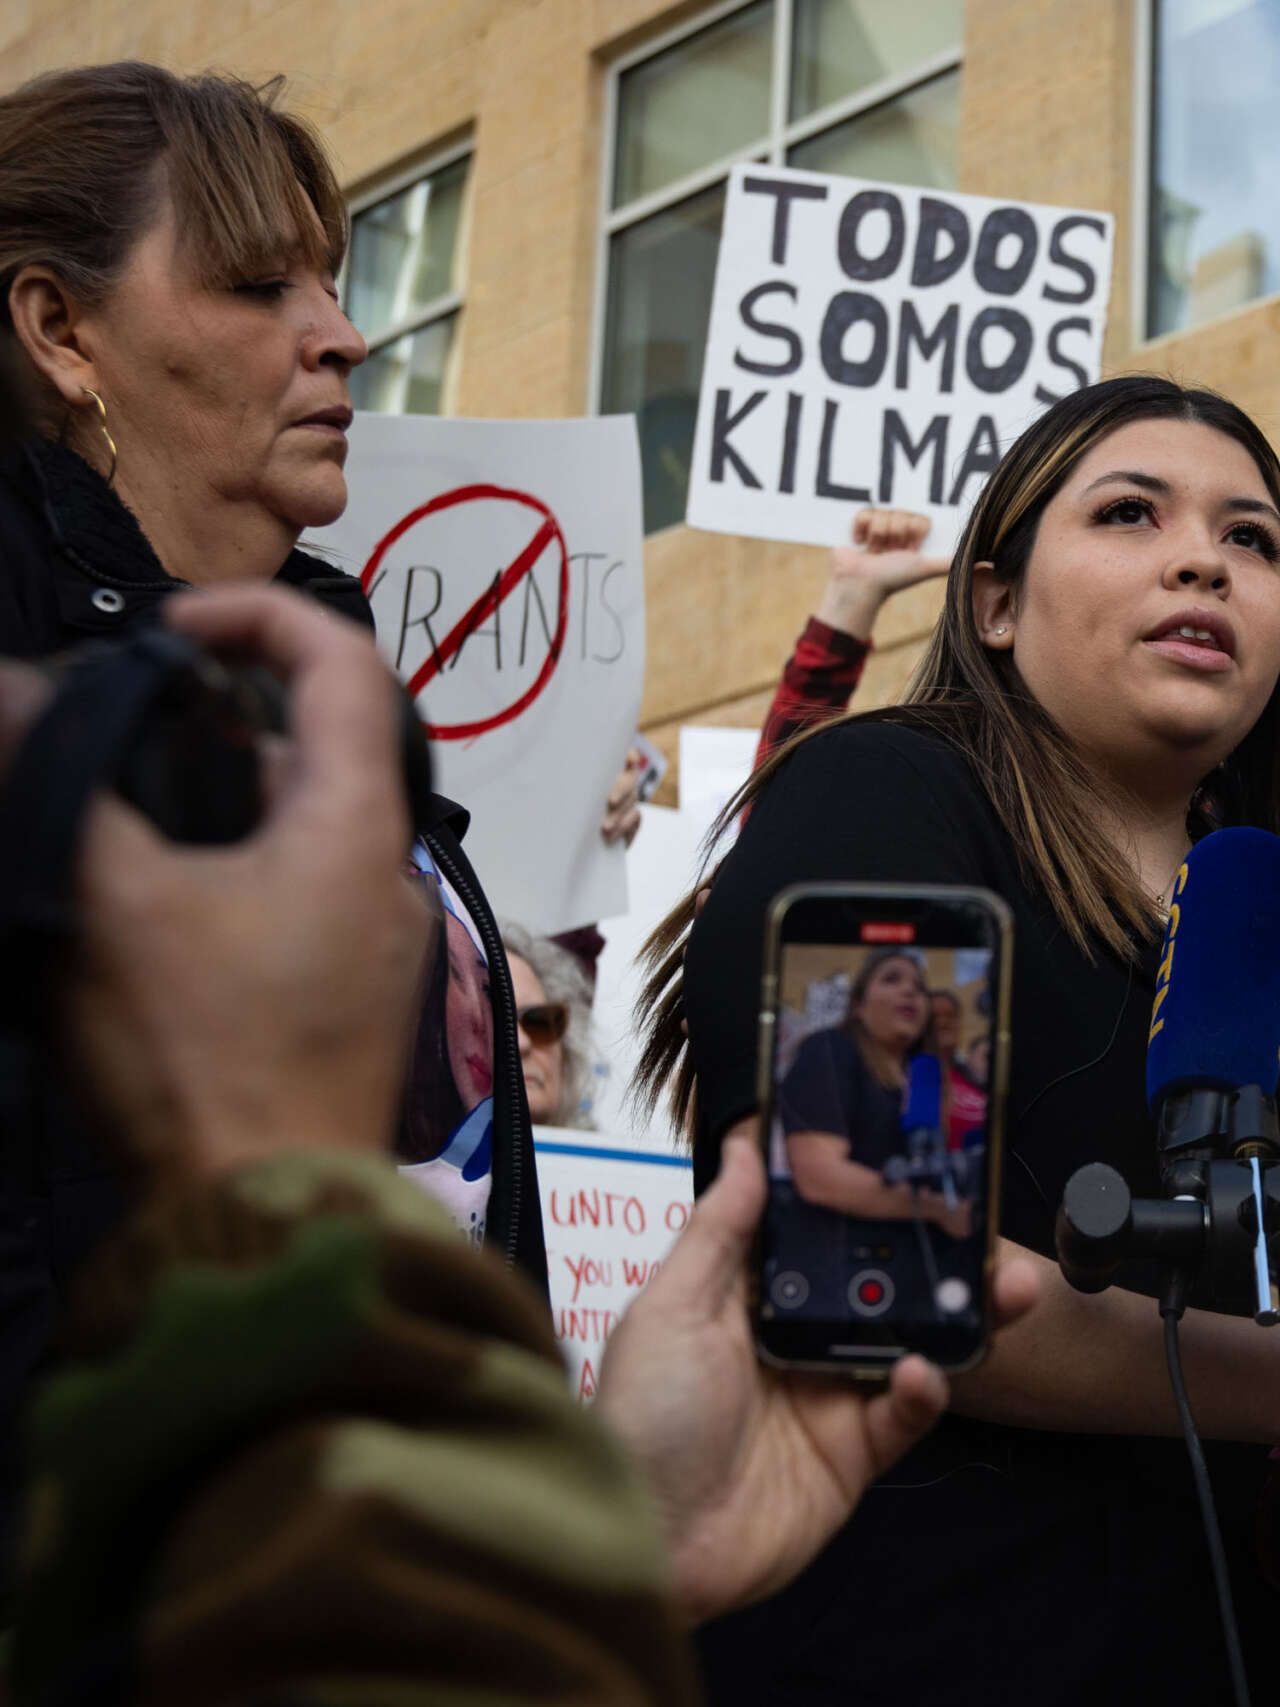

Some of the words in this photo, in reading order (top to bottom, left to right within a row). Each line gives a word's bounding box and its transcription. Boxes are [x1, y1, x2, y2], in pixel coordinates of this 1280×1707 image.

[743, 176, 1107, 305] TODOS
[734, 280, 1093, 406] SOMOS
[551, 1189, 645, 1234] UNTO
[665, 1201, 694, 1232] O
[564, 1254, 613, 1303] YOU
